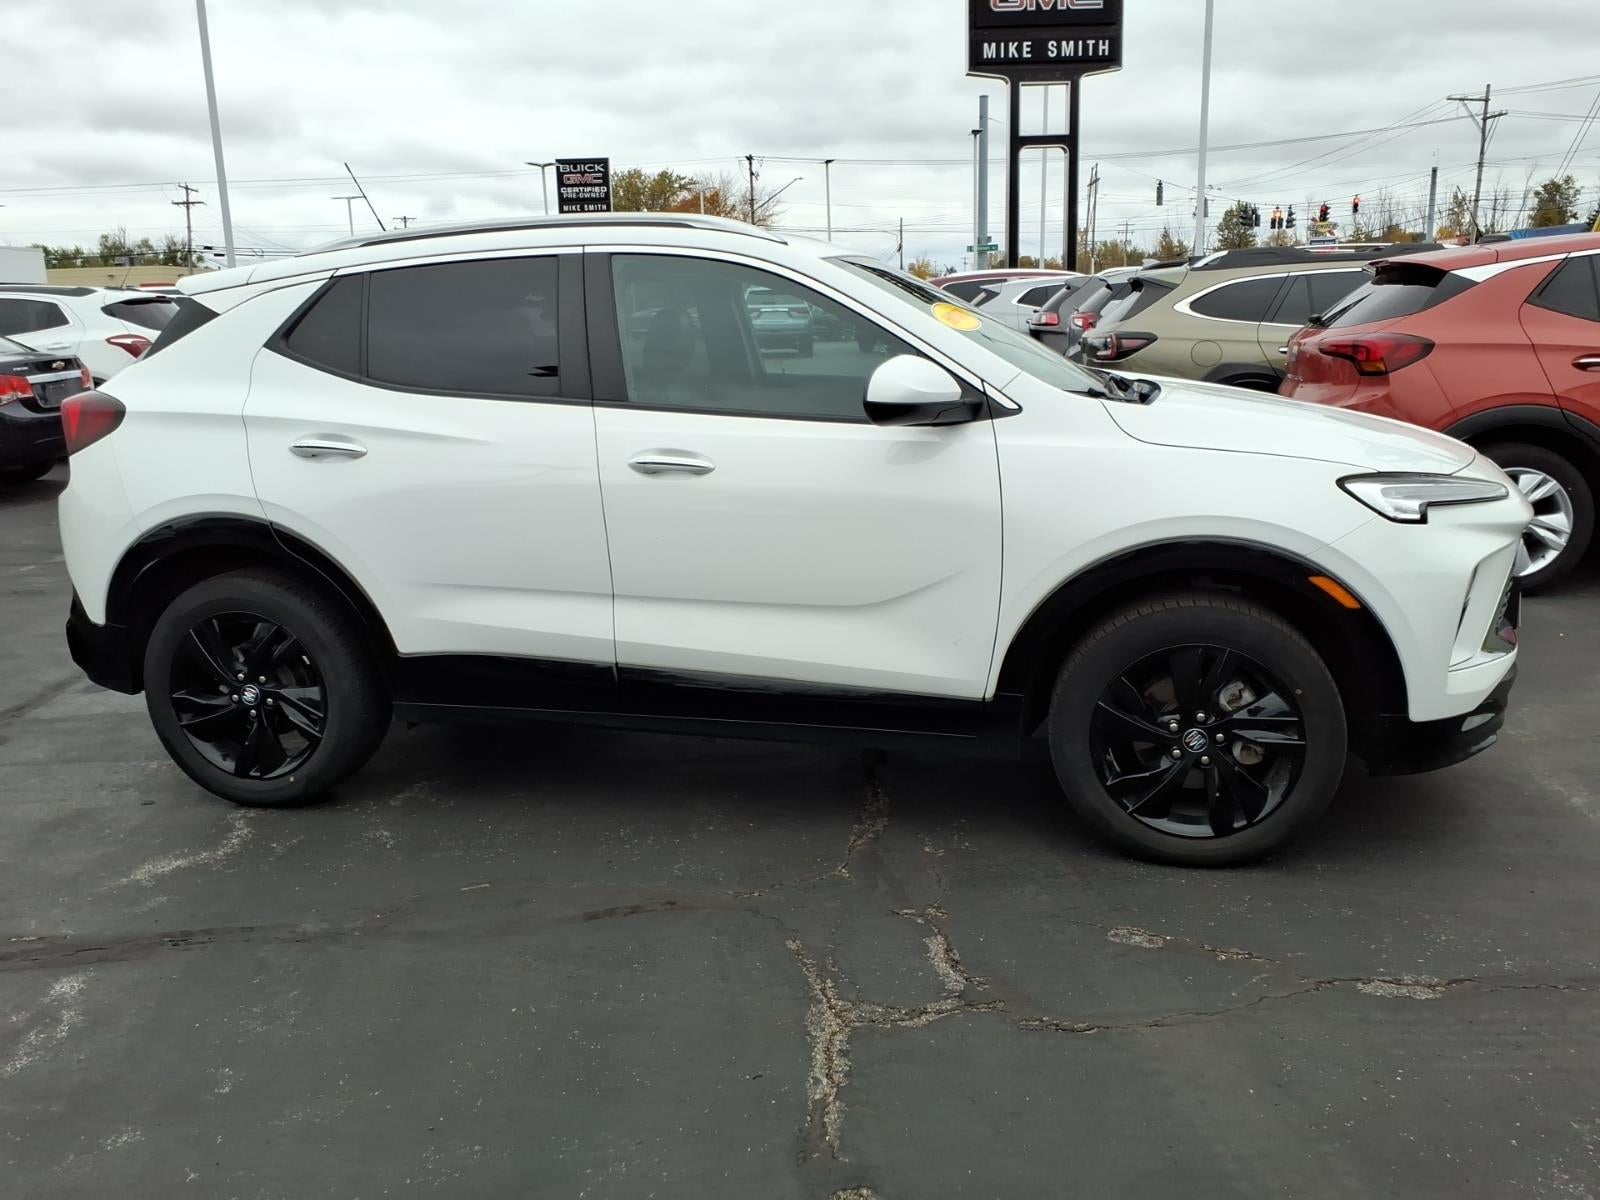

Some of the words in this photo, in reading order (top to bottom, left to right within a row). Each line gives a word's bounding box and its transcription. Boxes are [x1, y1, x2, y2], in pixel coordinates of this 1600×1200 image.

[983, 41, 1032, 59] MIKE
[1048, 40, 1109, 58] SMITH
[560, 164, 605, 172] BUICK
[563, 173, 603, 184] GMC
